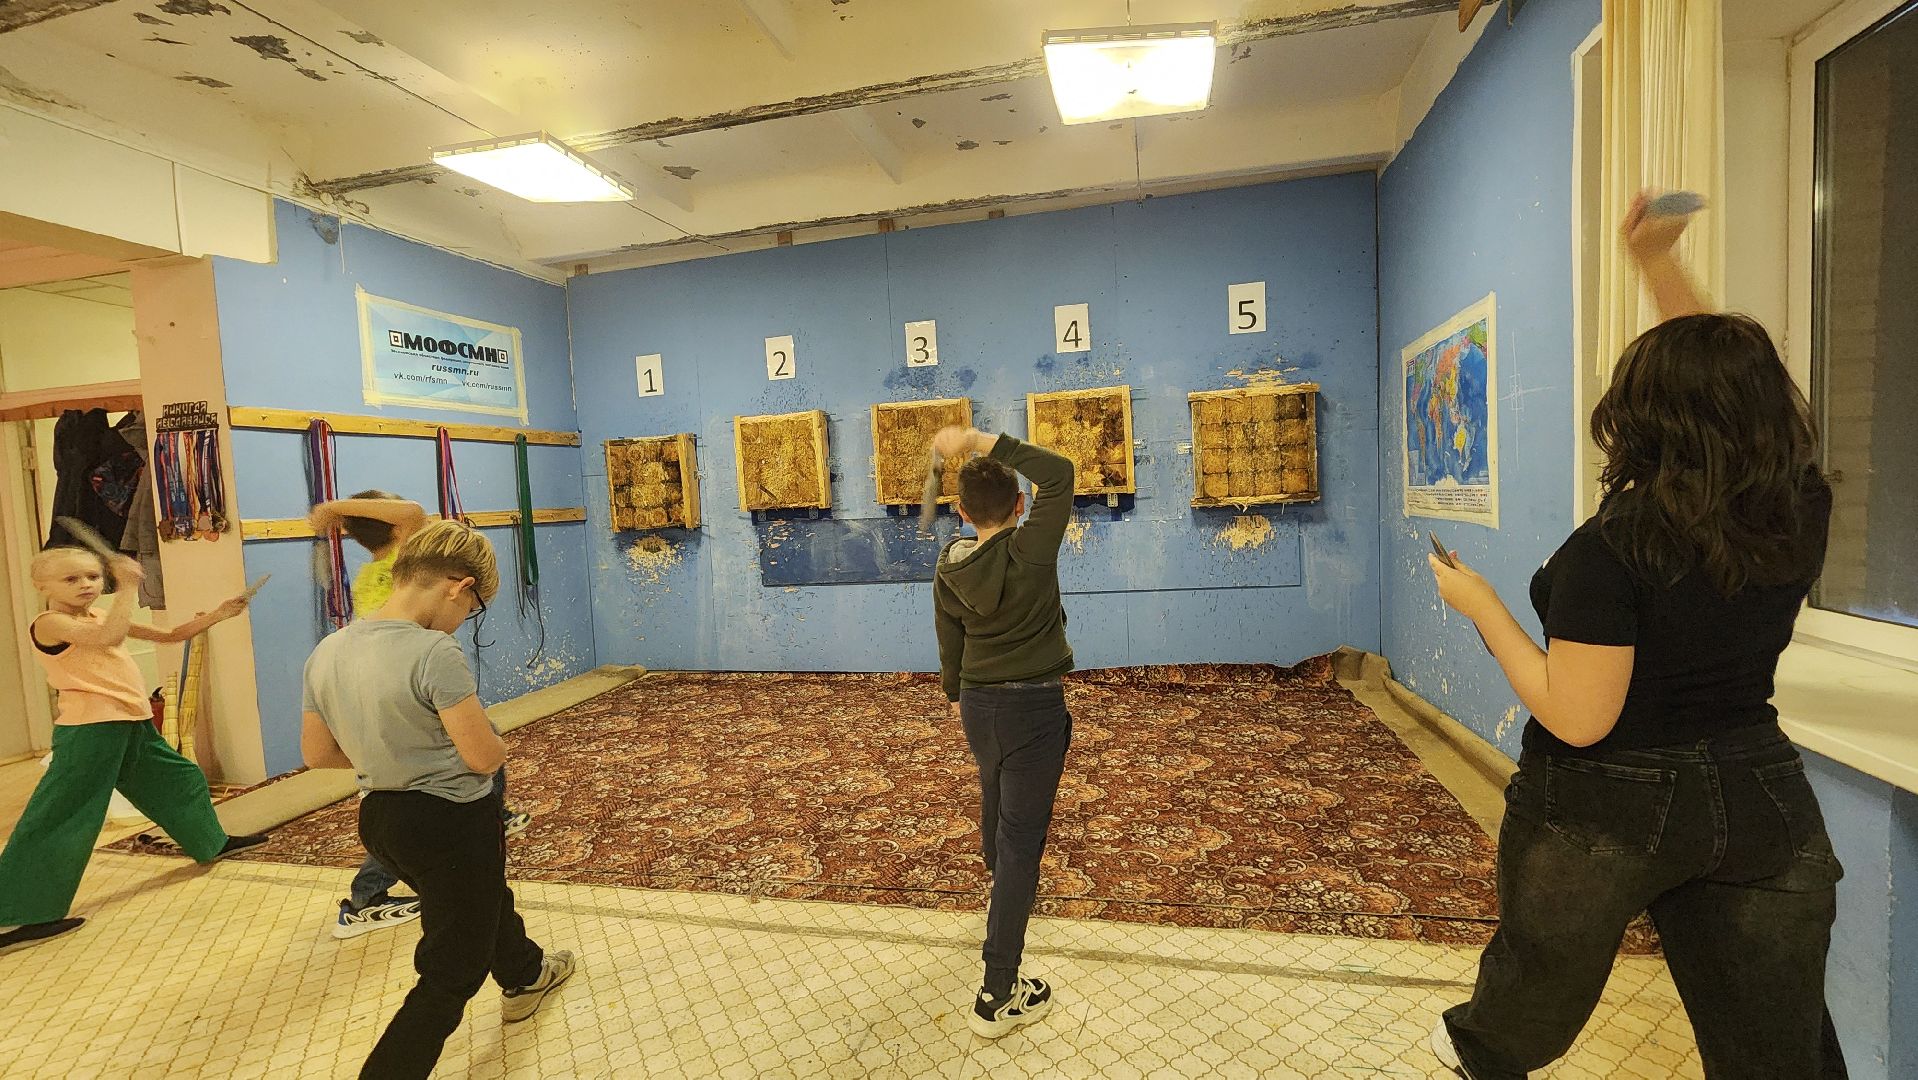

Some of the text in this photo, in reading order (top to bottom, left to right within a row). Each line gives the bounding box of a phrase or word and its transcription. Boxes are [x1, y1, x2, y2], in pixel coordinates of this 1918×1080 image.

[1238, 299, 1257, 330] 5
[1063, 320, 1083, 348] 4
[403, 332, 498, 363] МОФСМН
[914, 336, 930, 363] 3
[431, 363, 479, 376] russmn.ru
[773, 351, 789, 377] 2
[393, 372, 512, 392] vk.com/rfsmn vk.com/russmn
[644, 368, 658, 393] 1
